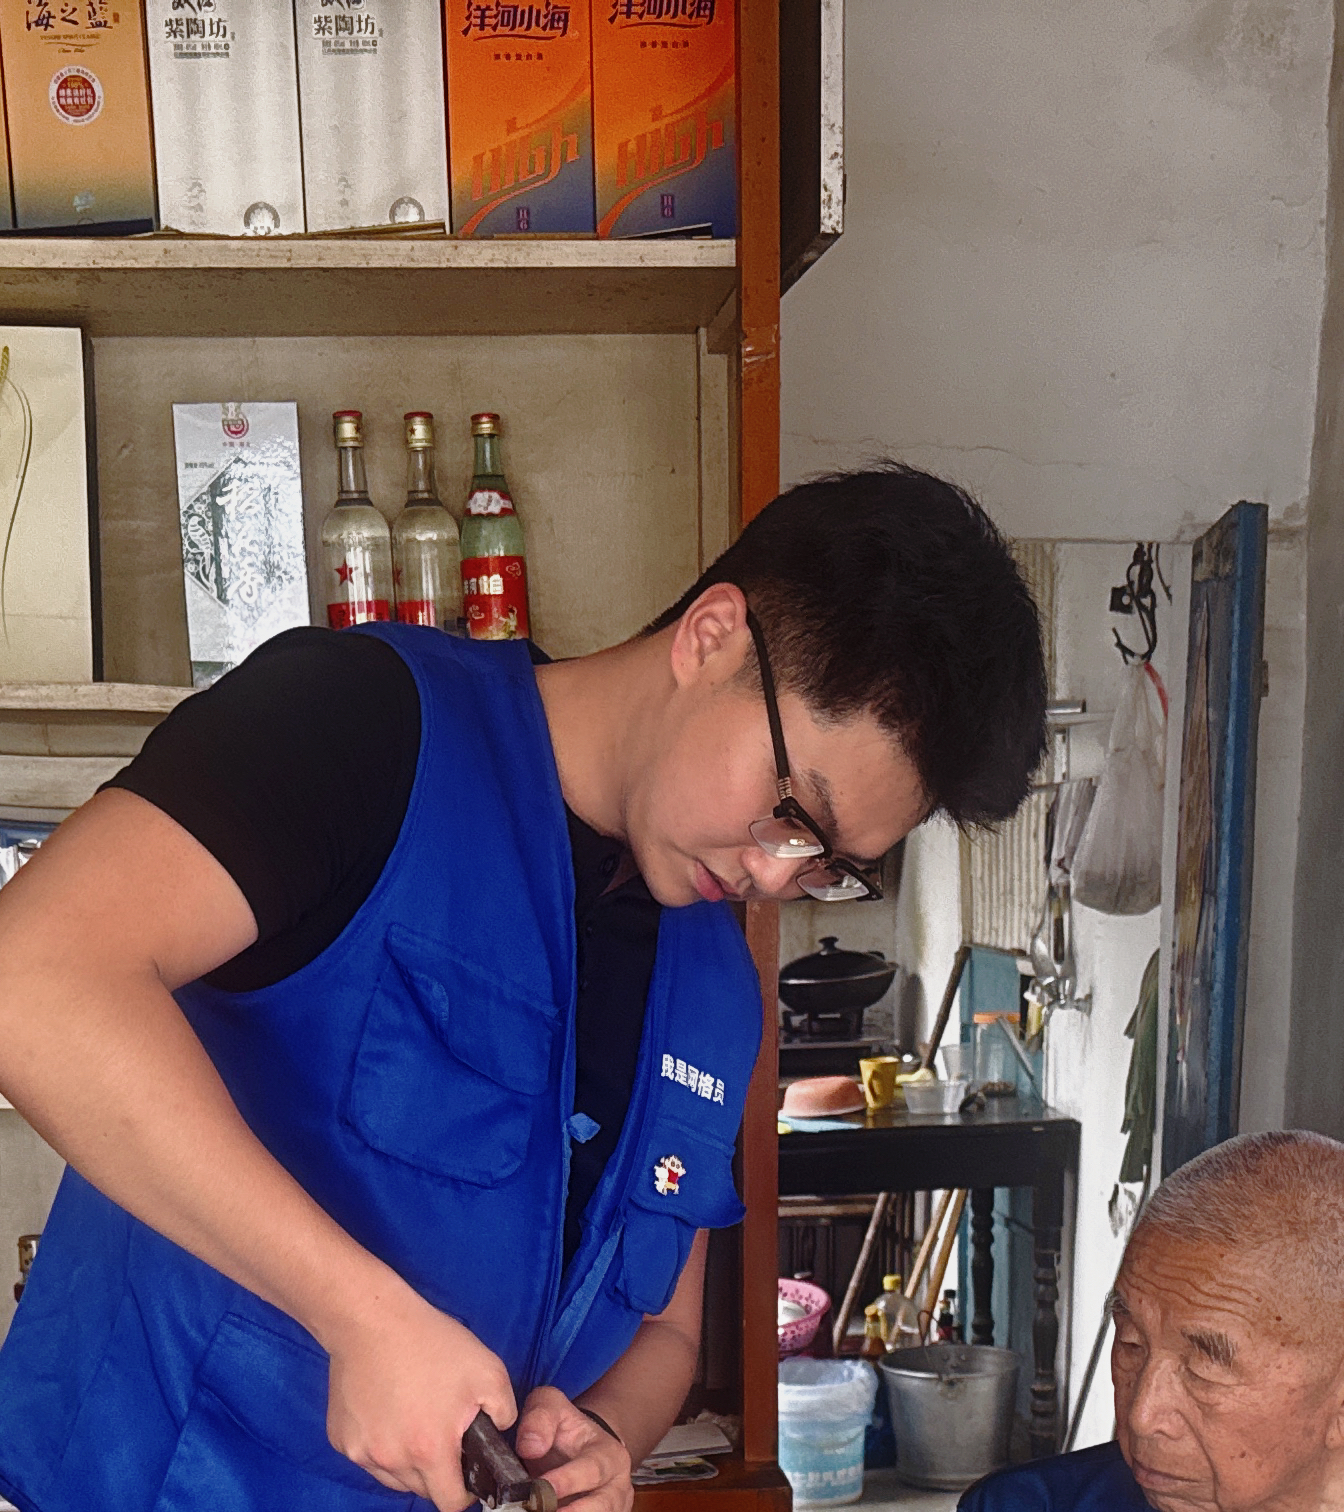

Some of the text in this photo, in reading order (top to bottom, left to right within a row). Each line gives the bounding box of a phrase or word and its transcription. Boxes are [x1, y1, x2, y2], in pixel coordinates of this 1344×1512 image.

[164, 17, 229, 40] 紫陶坊
[313, 14, 376, 36] 紫陶坊
[461, 0, 570, 38] 洋河小海
[660, 1053, 725, 1107] 我是网格员
